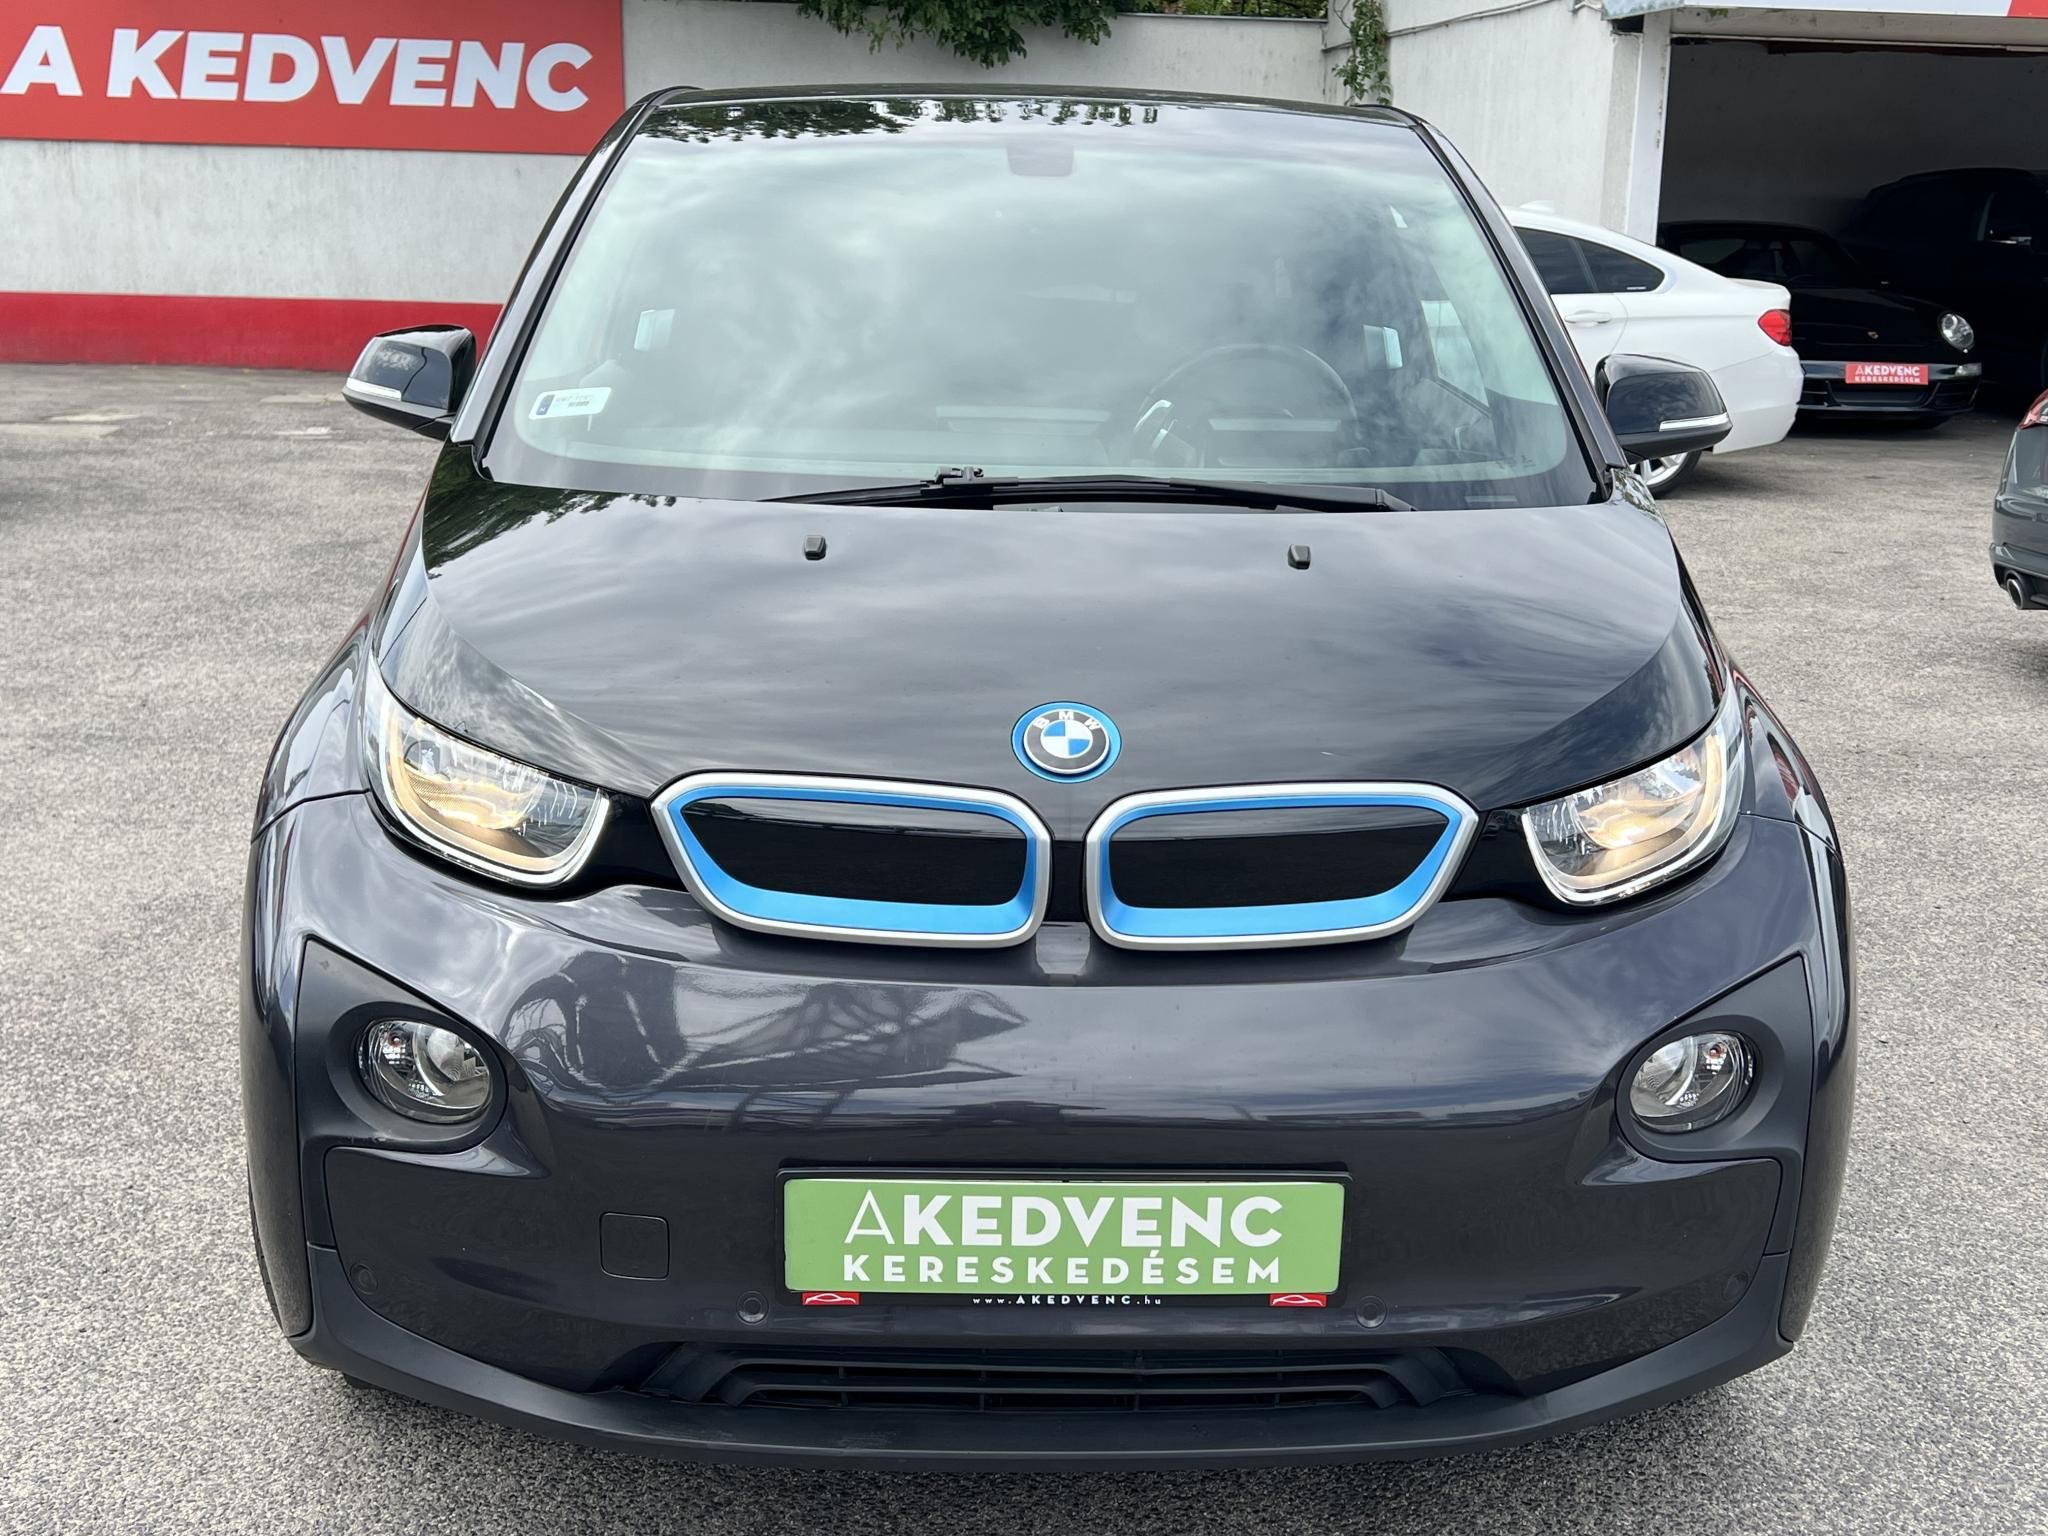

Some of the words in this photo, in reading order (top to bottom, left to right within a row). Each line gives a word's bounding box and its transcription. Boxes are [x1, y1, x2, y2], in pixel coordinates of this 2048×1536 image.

[1, 25, 83, 97] A
[106, 28, 594, 112] KEDVENC
[1033, 710, 1101, 730] BMW
[843, 1250, 1280, 1285] KERESKEDÉSEM
[973, 1295, 1161, 1305] www.AKEDVENC.hu
